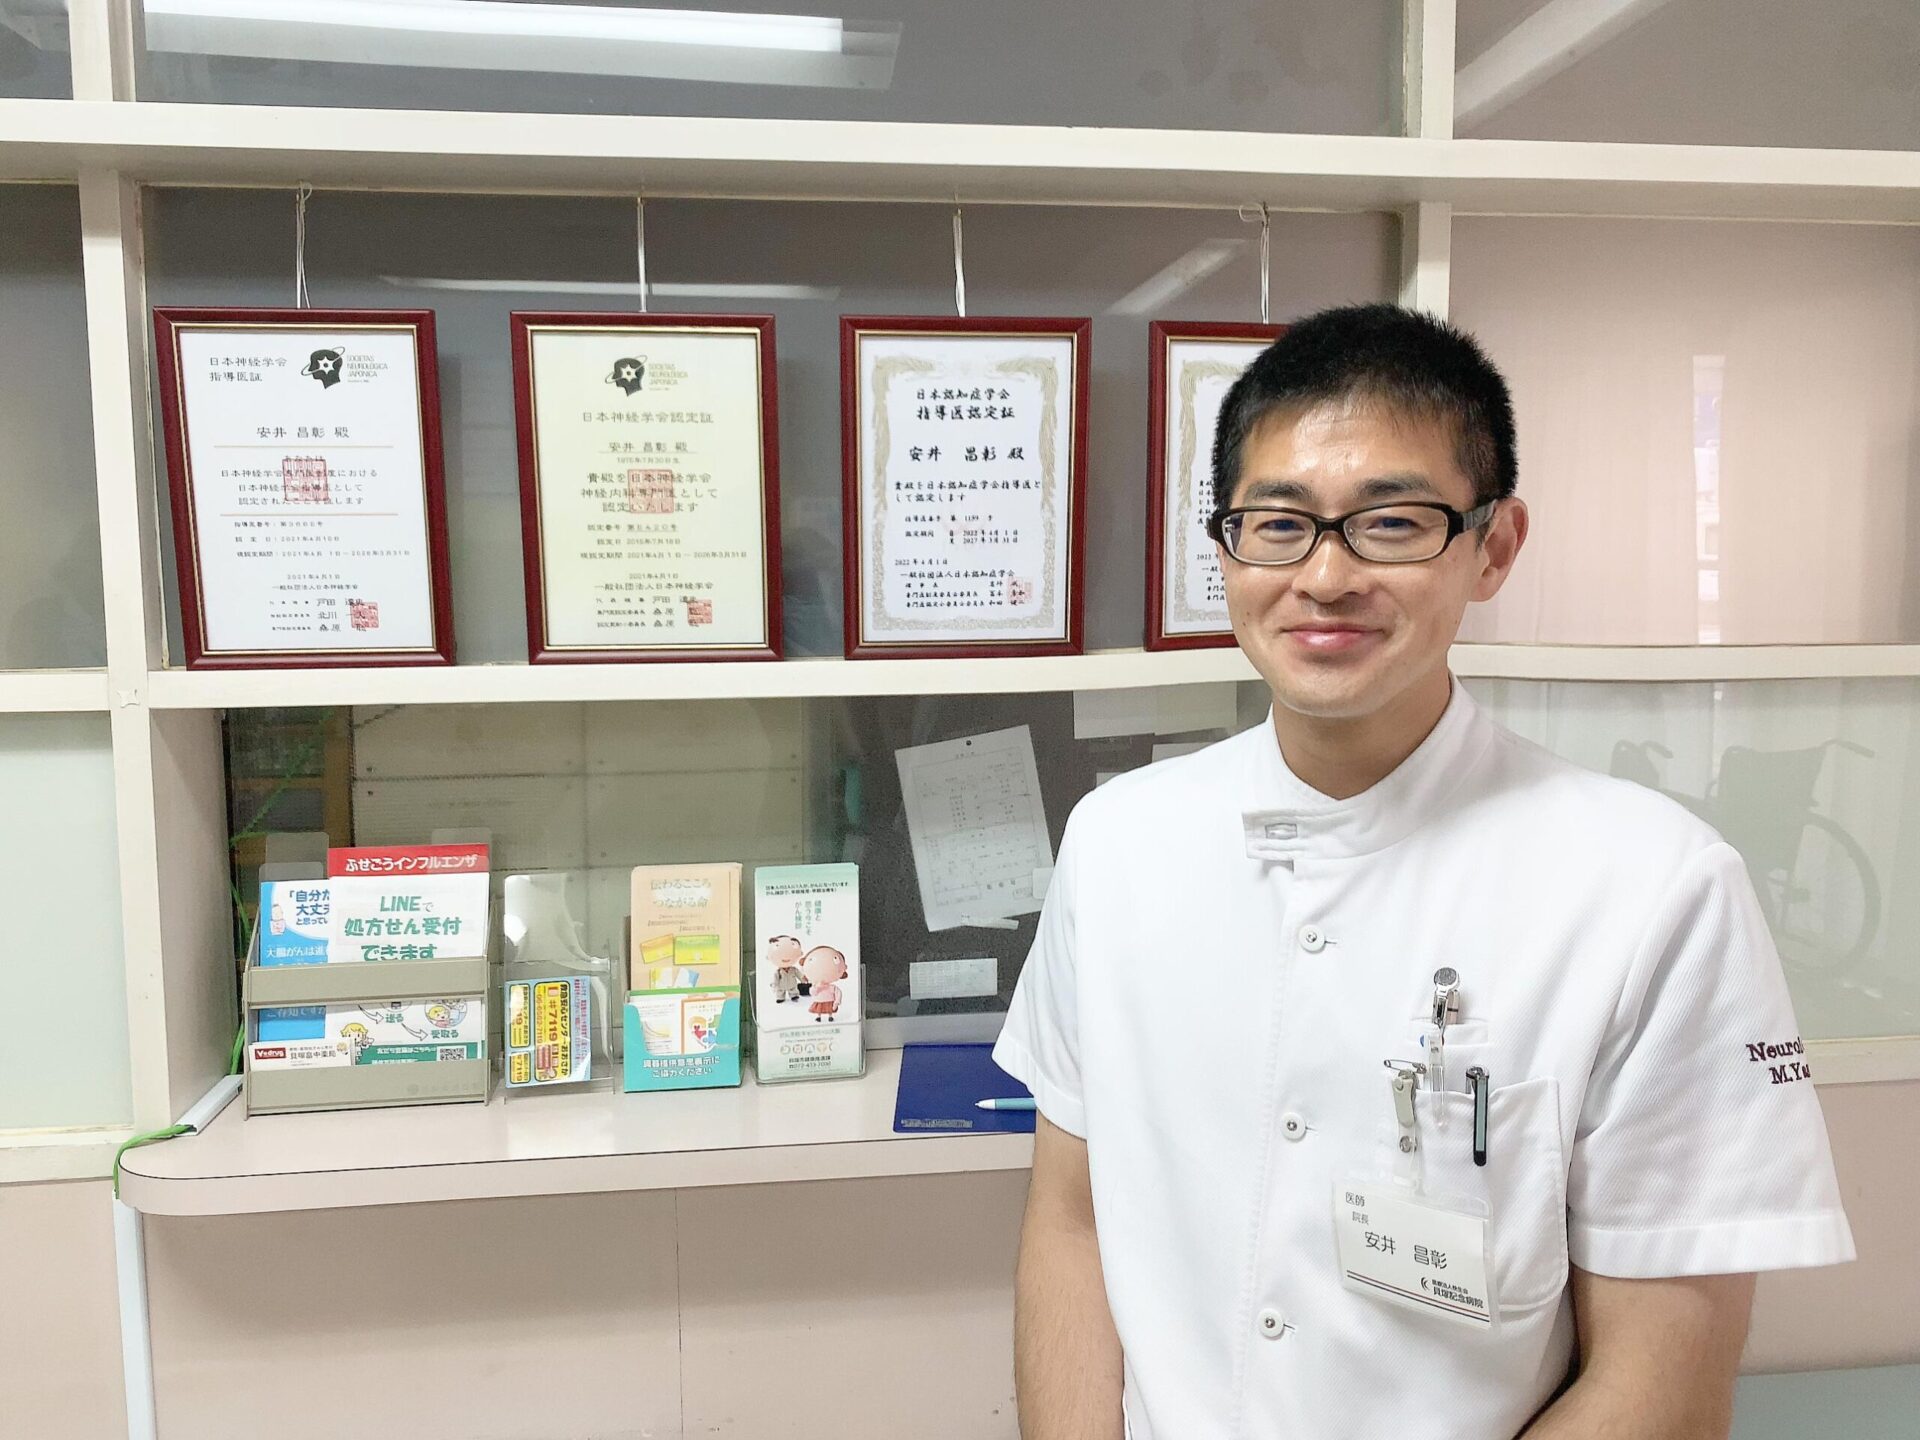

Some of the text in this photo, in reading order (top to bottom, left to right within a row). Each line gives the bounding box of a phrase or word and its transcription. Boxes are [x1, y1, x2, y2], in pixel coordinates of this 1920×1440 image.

[209, 357, 288, 368] 日本神経学会
[209, 371, 263, 382] 指導医証
[917, 388, 1011, 400] 日本認知症学会
[583, 412, 714, 424] 日本神経学会認定証
[917, 405, 1016, 420] 指導医認定証
[256, 427, 350, 439] 安井 昌彰 殿
[909, 446, 942, 462] 安井
[965, 446, 996, 462] 昌彰
[345, 854, 478, 872] ふせごうインフルエンザ
[344, 917, 462, 936] 処方せん受付
[361, 943, 438, 961] できます
[652, 1067, 712, 1079] ご協力ください
[1345, 1192, 1365, 1207] 医師
[1352, 1211, 1370, 1225] 院長
[1365, 1231, 1448, 1269] 安井 昌彰
[1433, 1286, 1485, 1309] 貝塚記念病院
